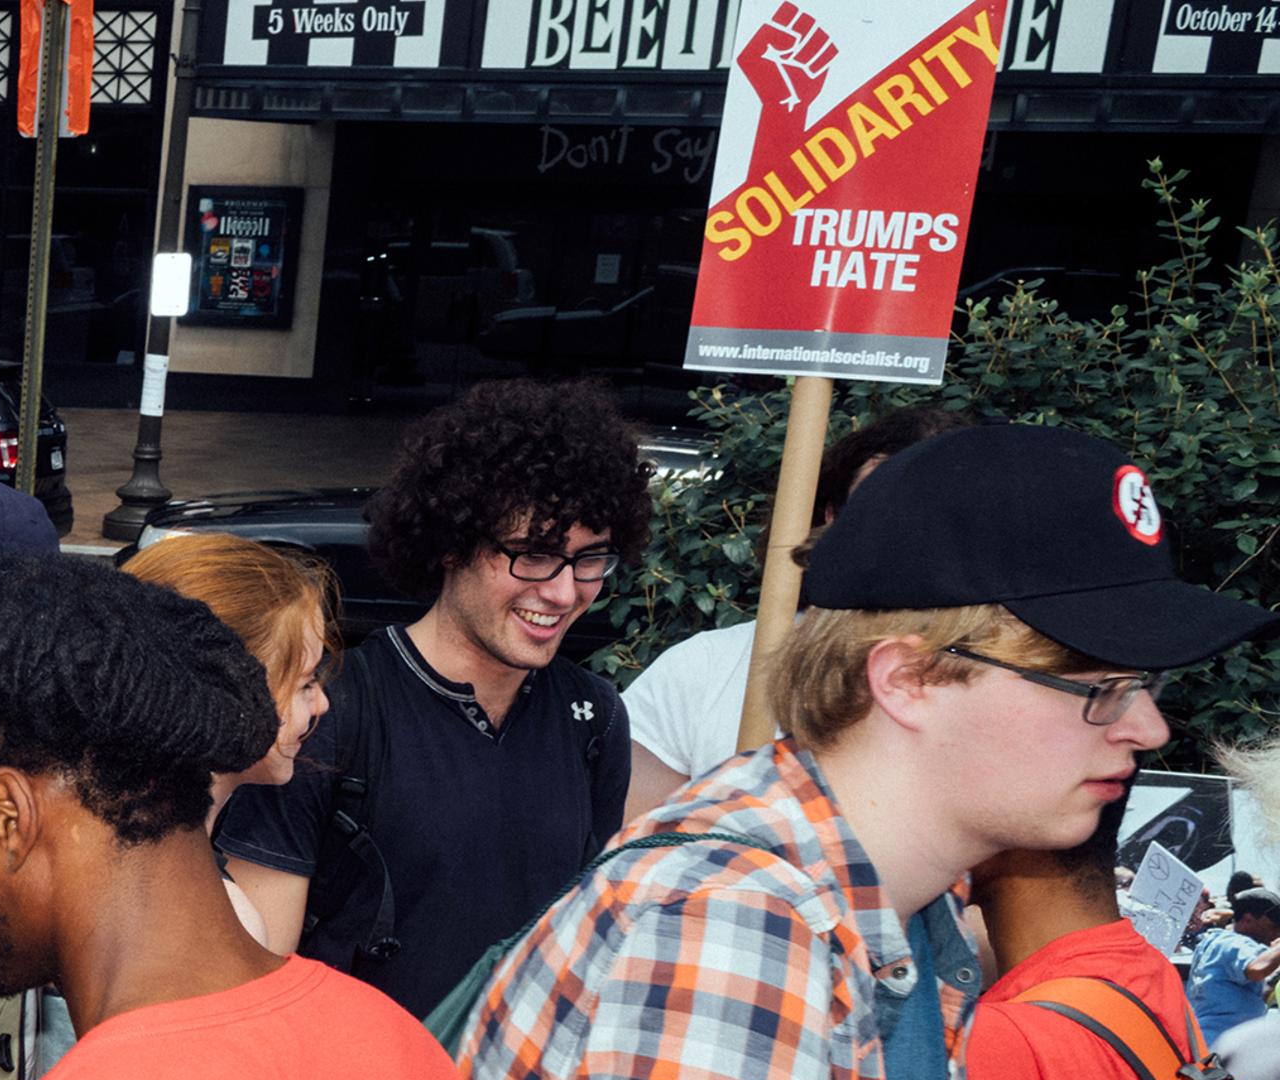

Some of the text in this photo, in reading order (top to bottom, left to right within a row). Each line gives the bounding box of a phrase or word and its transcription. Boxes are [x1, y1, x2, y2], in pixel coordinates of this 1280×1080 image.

[267, 5, 410, 36] 5 Weeks Only
[1175, 3, 1252, 32] October
[650, 127, 716, 184] Say
[704, 10, 1001, 262] SOLIDARITY
[790, 207, 959, 252] TRUMPS
[810, 250, 921, 292] HATE
[697, 343, 931, 374] www.internationalsocialist.org
